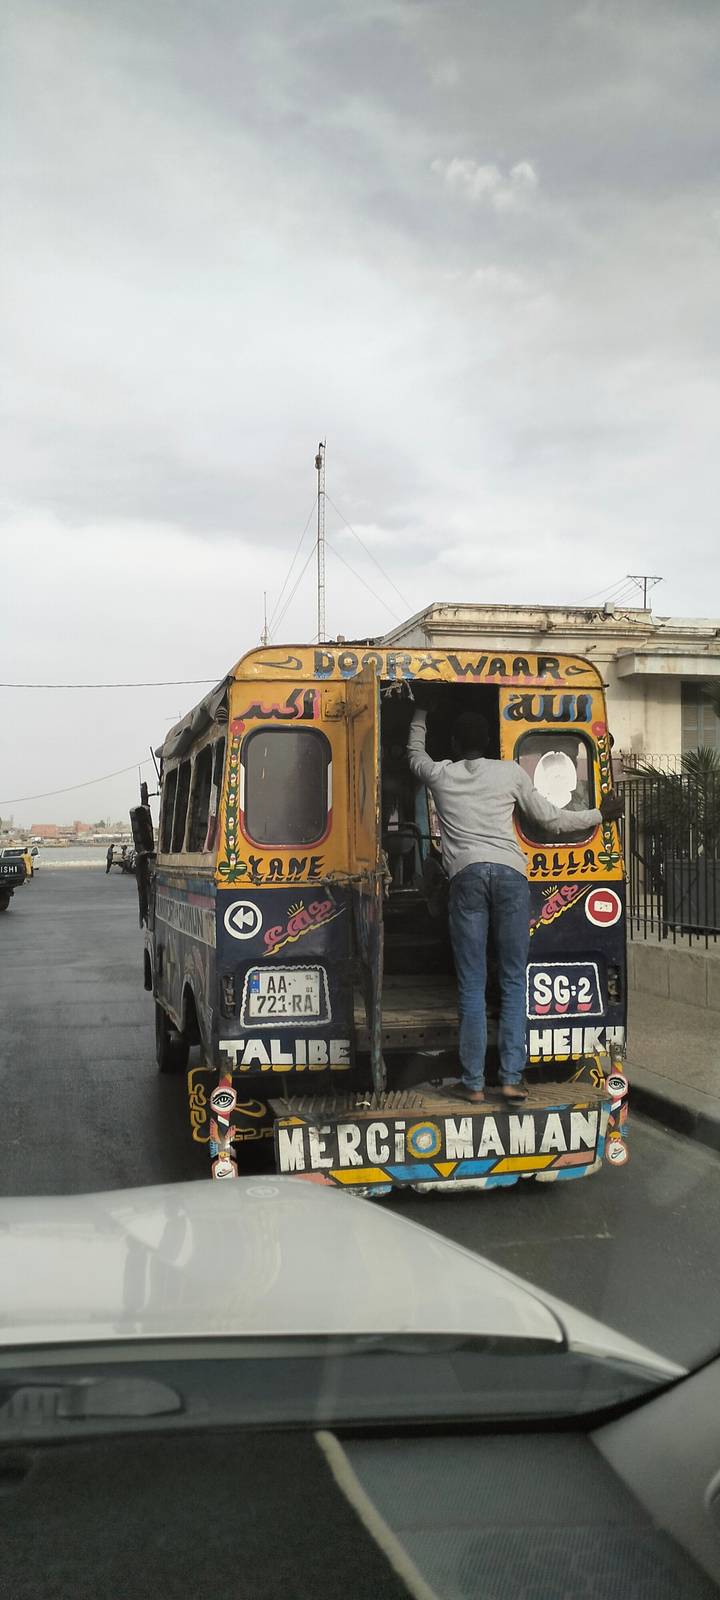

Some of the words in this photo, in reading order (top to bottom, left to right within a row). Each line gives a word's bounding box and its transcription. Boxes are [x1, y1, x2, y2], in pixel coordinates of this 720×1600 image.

[313, 650, 416, 678] DOOR
[447, 654, 565, 682] WAAR
[525, 849, 599, 877] ALLA
[533, 972, 593, 1012] SG:2
[218, 1038, 351, 1071] TALIBE
[525, 1025, 627, 1062] HEIKH
[444, 1110, 599, 1160] MAMAN
